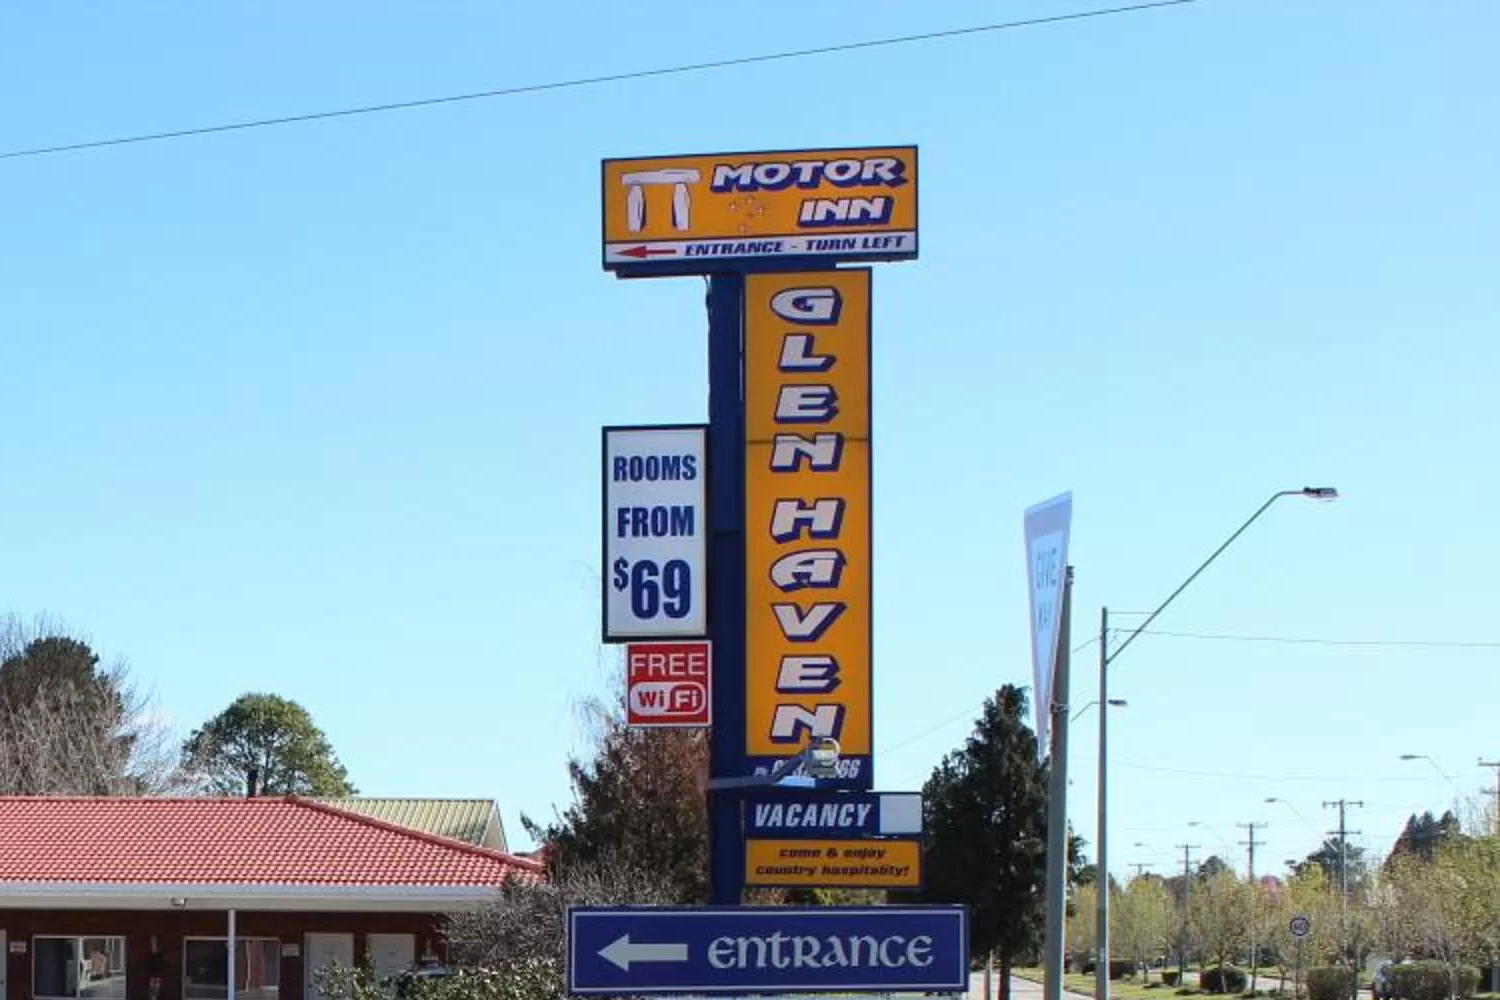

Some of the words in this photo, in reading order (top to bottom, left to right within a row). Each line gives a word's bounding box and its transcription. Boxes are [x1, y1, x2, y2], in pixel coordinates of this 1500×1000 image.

[711, 157, 906, 191] MOTOR
[799, 196, 894, 227] INN
[685, 240, 784, 257] ENTRANCE
[806, 238, 856, 252] TURN
[861, 235, 906, 249] LEFT
[613, 455, 697, 482] ROOMS
[617, 505, 695, 538] FROM
[769, 285, 847, 744] GLENHAVEN
[613, 557, 691, 619] $69
[631, 653, 705, 677] FREE
[756, 803, 871, 828] VACANCY
